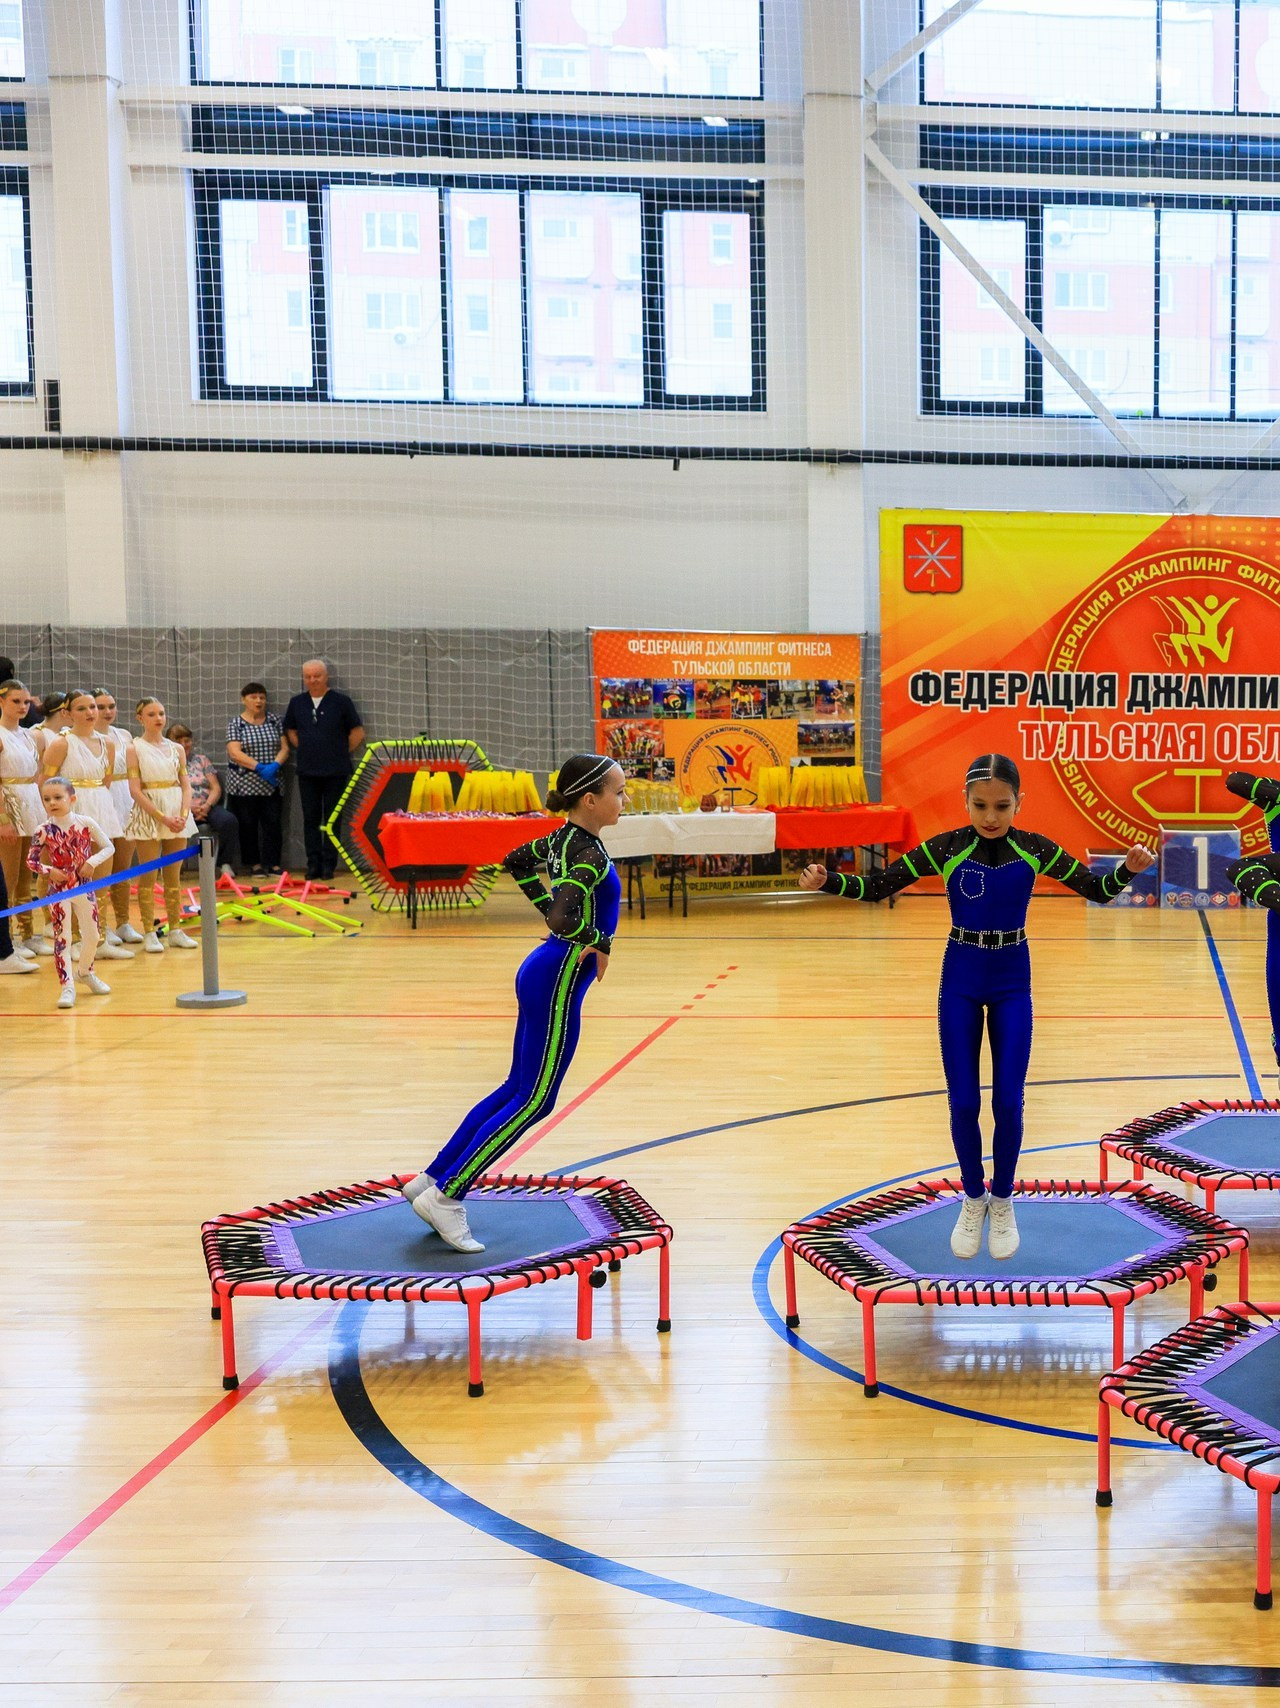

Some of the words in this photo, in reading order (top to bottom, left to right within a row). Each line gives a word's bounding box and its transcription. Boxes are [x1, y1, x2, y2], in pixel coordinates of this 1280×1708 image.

[1055, 590, 1115, 673] ДЕРАЦИЯ
[1116, 556, 1232, 597] ДЖАМПИНГ
[627, 639, 702, 656] ФЕДЕРАЦИЯ
[705, 640, 775, 657] ДЖАМПИНГ
[777, 641, 832, 657] ФИТНЕСА
[672, 659, 735, 675] ТУЛЬСКОЙ
[738, 661, 791, 676] ОБЛАСТИ
[909, 670, 1118, 712] ФЕДЕРАЦИЯ
[1018, 720, 1205, 762] ТУЛЬСКАЯ
[1096, 809, 1158, 849] JUMPI
[1192, 837, 1208, 889] 1
